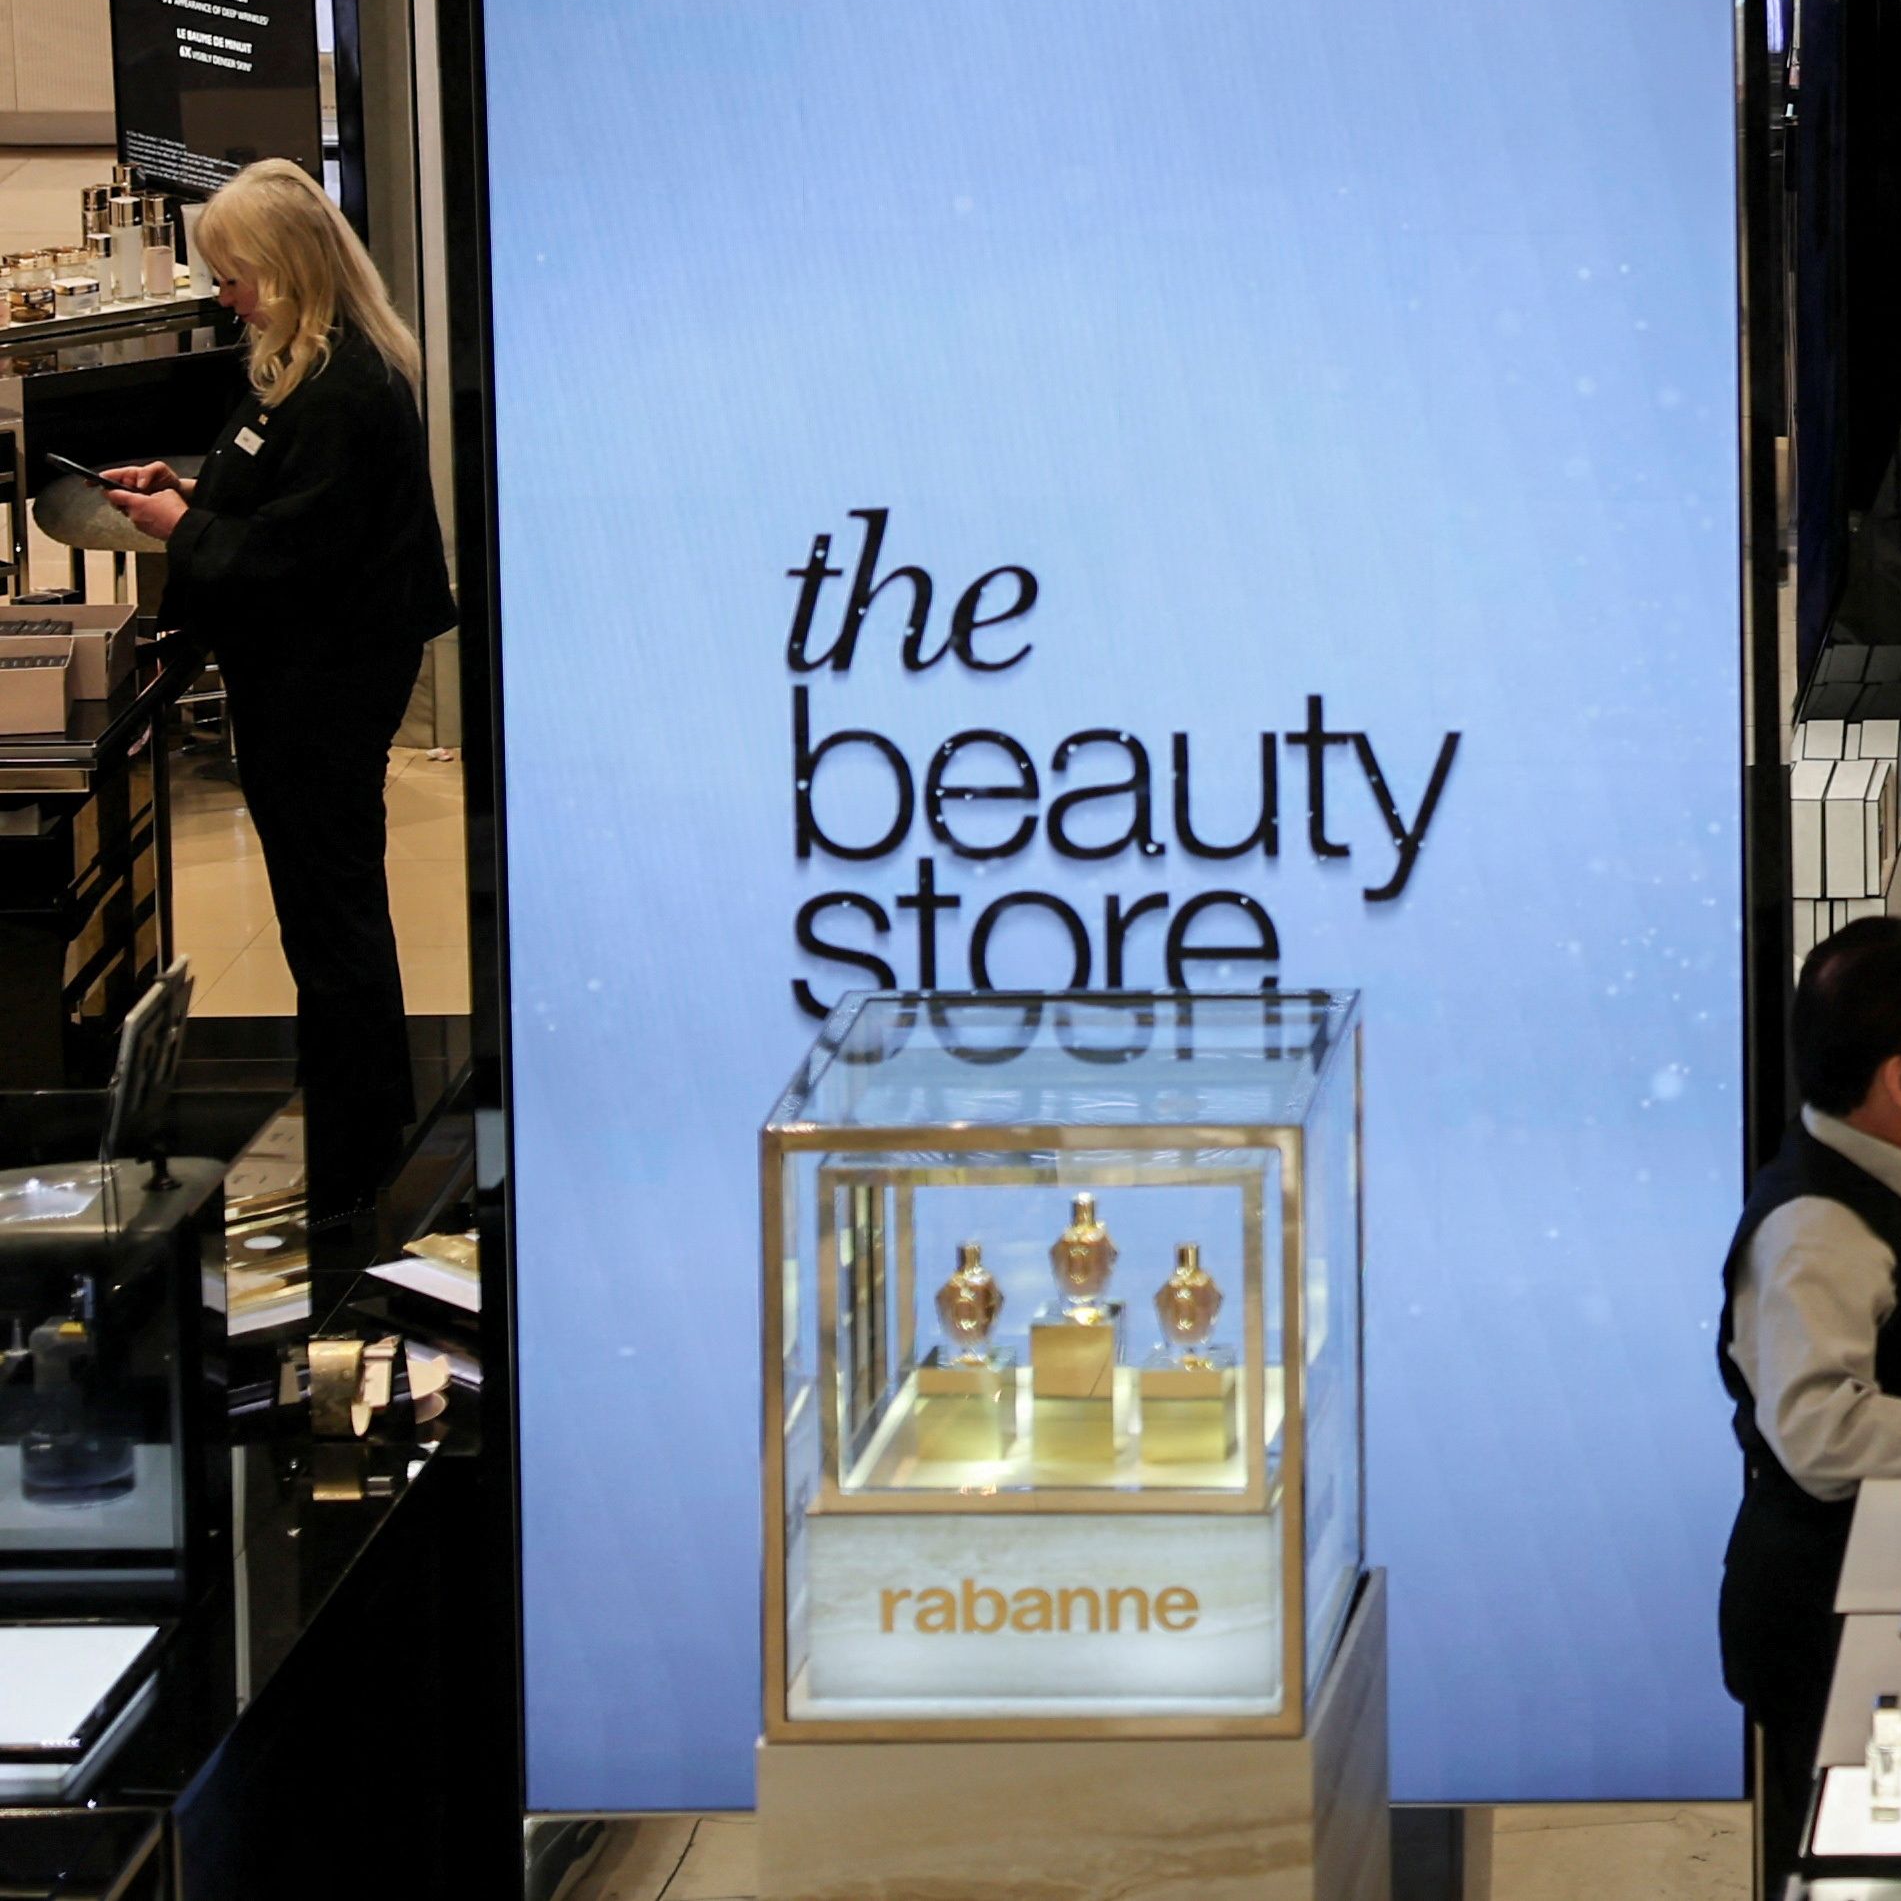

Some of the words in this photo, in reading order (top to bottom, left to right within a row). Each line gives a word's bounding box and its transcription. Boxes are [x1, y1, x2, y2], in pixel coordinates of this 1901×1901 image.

[176, 27, 187, 40] LE
[186, 29, 213, 46] BAUME
[212, 35, 225, 48] DE
[224, 38, 253, 54] MINUIT
[212, 5, 222, 16] OF
[221, 6, 237, 19] DEEP
[785, 506, 1040, 673] the
[791, 683, 1463, 902] beauty
[790, 857, 1281, 1023] store
[878, 1577, 1201, 1635] rabanne
